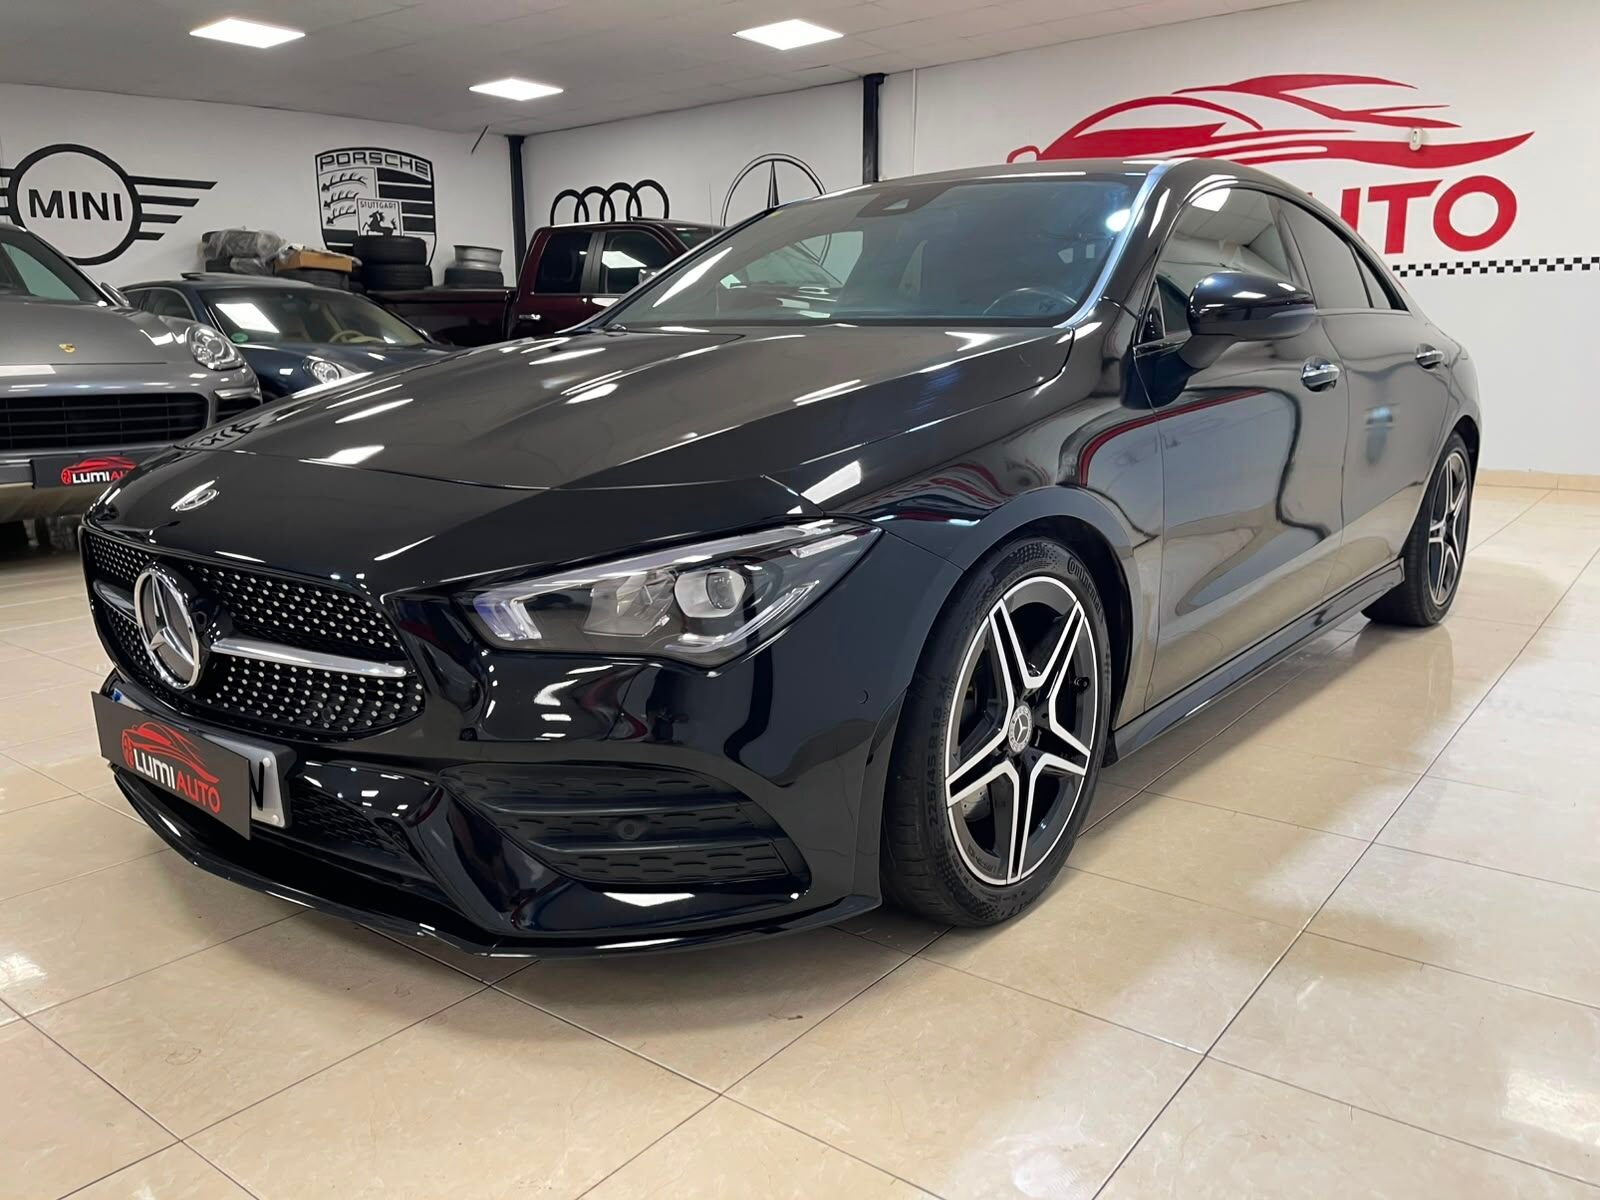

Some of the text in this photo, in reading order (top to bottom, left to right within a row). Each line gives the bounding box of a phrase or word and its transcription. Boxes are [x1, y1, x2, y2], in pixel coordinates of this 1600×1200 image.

[319, 151, 430, 180] PORSCHE
[28, 188, 123, 222] MINI
[360, 200, 398, 210] STUTTGART
[132, 748, 221, 814] LUMIAUTO
[926, 754, 939, 828] 225/45
